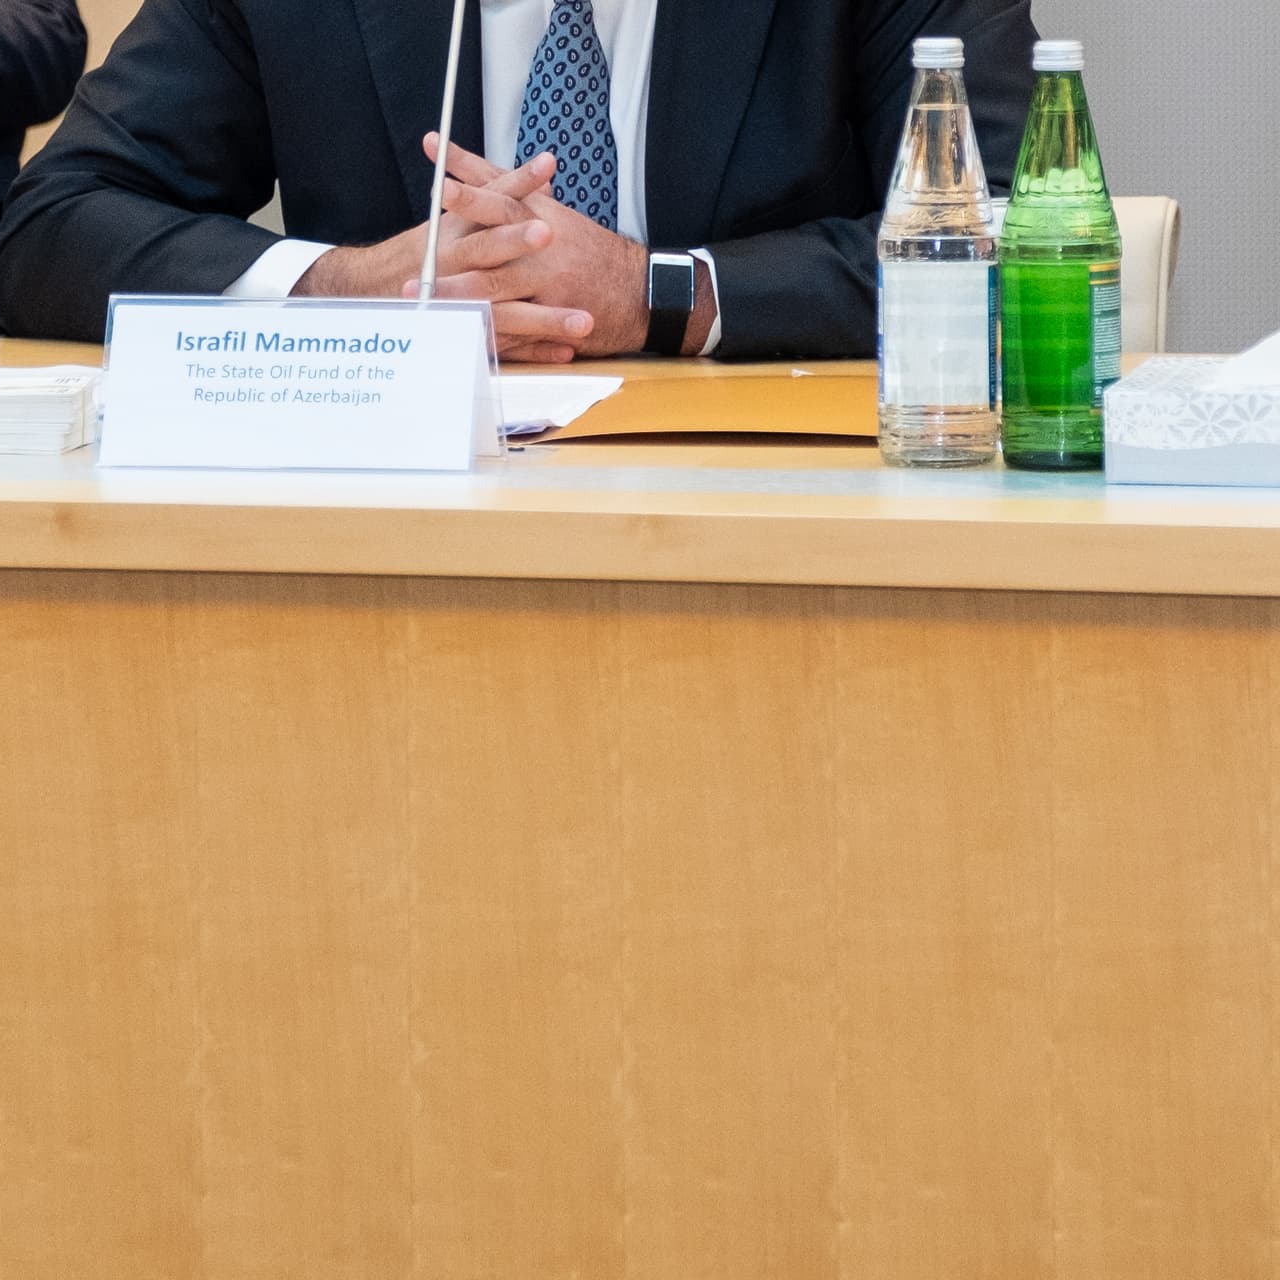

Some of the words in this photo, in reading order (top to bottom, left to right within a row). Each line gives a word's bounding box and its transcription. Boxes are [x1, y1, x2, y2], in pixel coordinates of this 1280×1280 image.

[176, 331, 246, 352] Israfil
[255, 332, 412, 354] Mammadov
[186, 364, 216, 379] The
[222, 365, 264, 379] State
[270, 365, 292, 380] Oil
[298, 365, 340, 380] Fund
[345, 365, 363, 380] of
[367, 365, 395, 381] the
[193, 388, 266, 404] Republic
[271, 388, 288, 403] of
[292, 389, 382, 407] Azerbaijan
